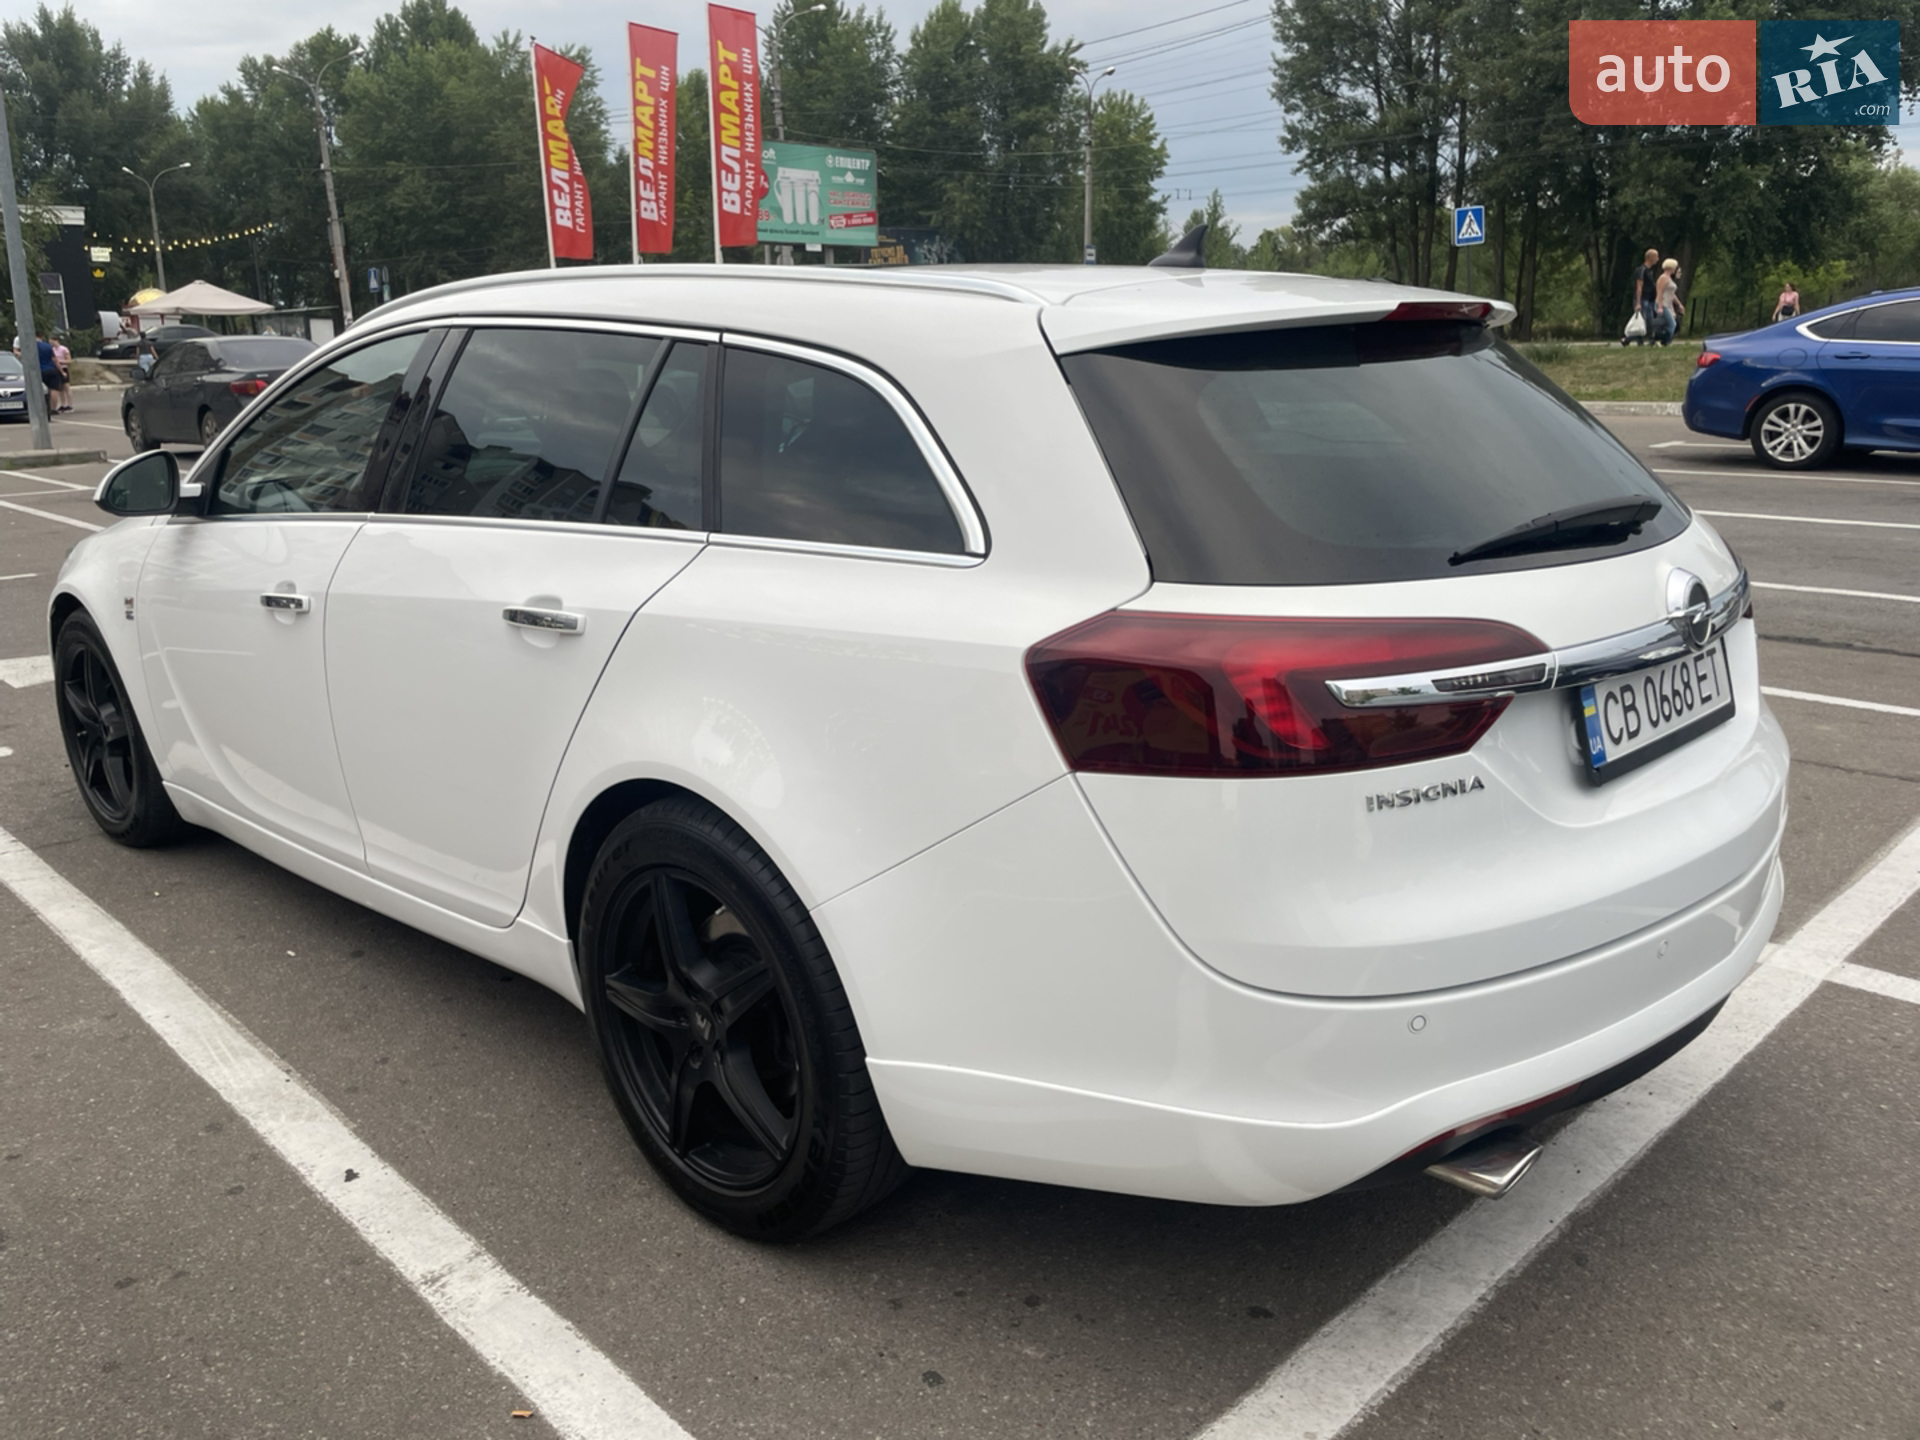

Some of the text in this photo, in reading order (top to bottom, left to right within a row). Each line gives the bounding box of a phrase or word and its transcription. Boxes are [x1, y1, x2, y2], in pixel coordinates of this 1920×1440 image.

[635, 57, 660, 222] ВЕЛМАРТ
[658, 65, 670, 226] ГАРАНТ НИЗЬКИХ ЦІН
[717, 40, 741, 214] ВЕЛМАРТ
[741, 47, 755, 216] ГАРАНТ НИЗЬКИХ ЦІН
[573, 182, 586, 233] ГАРАНТ
[1589, 735, 1604, 755] UA
[1604, 647, 1720, 746] CB 0668 ET
[1366, 775, 1485, 812] INSIGNIA
